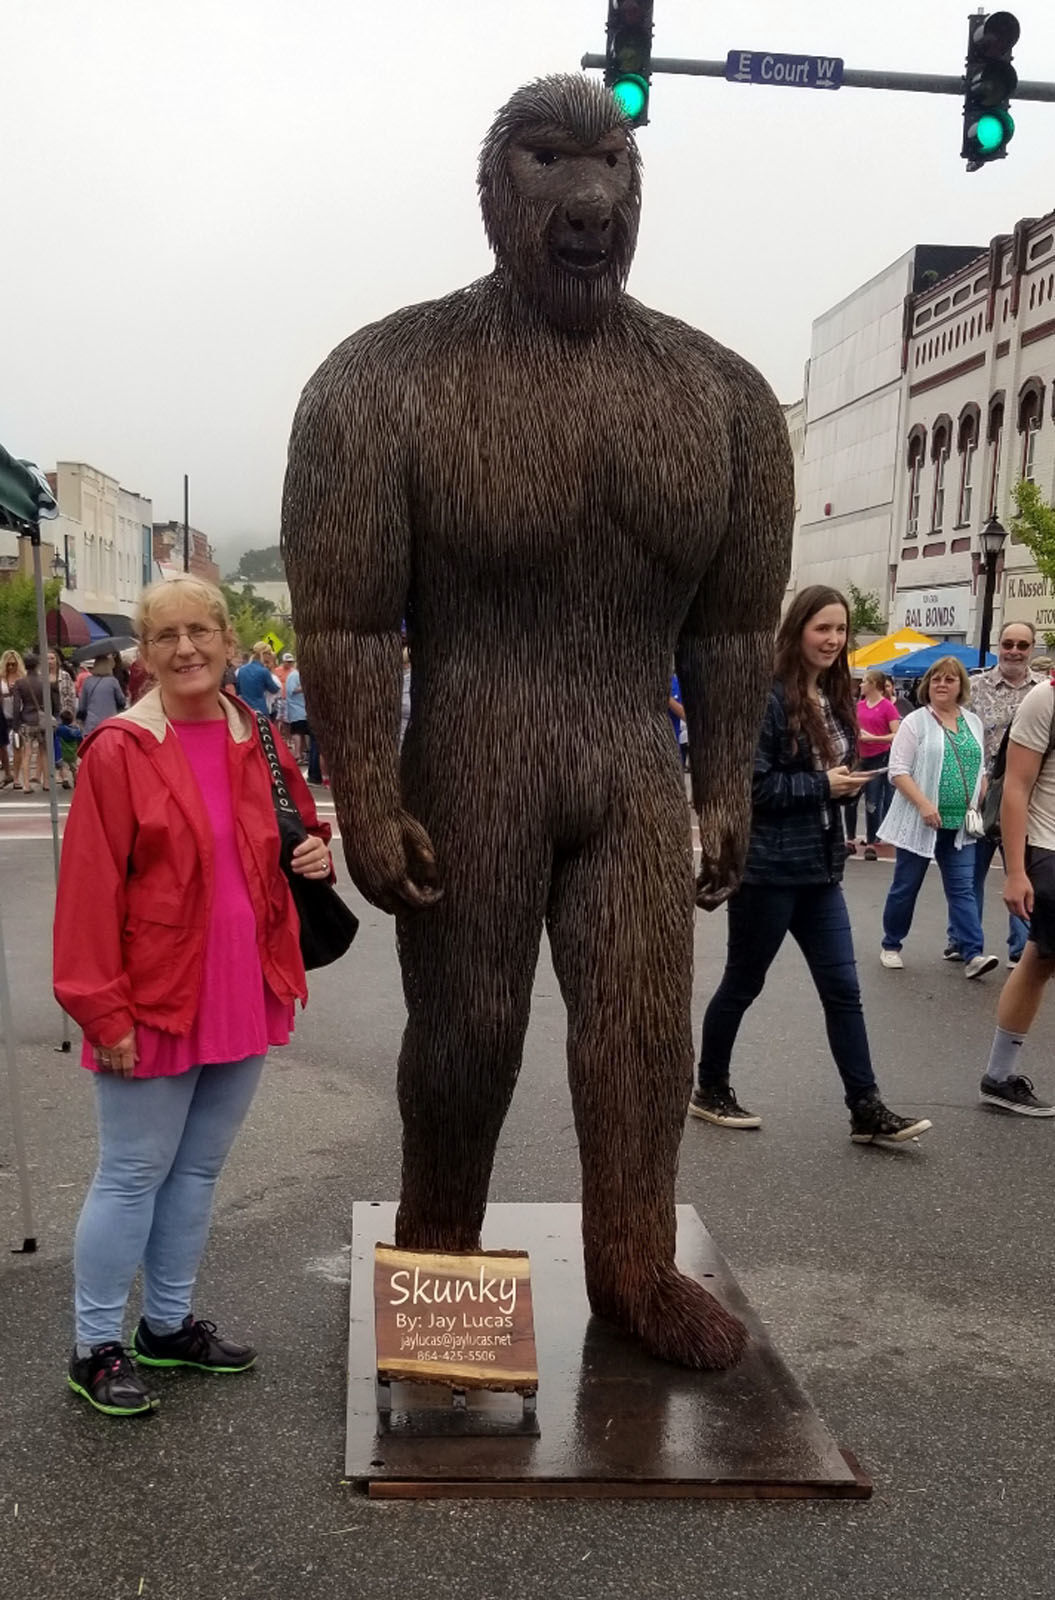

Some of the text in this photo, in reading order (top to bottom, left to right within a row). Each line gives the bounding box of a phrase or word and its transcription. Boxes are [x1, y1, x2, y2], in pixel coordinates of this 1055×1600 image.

[739, 53, 836, 83] E Court W
[1018, 576, 1048, 598] Russell
[905, 606, 955, 627] BAIL BONDS
[389, 1265, 517, 1314] Skunky
[396, 1313, 514, 1331] By: Jay Lucas
[400, 1332, 512, 1350] jaylucas@jaylucas.net
[417, 1350, 496, 1361] 864-425-5506
